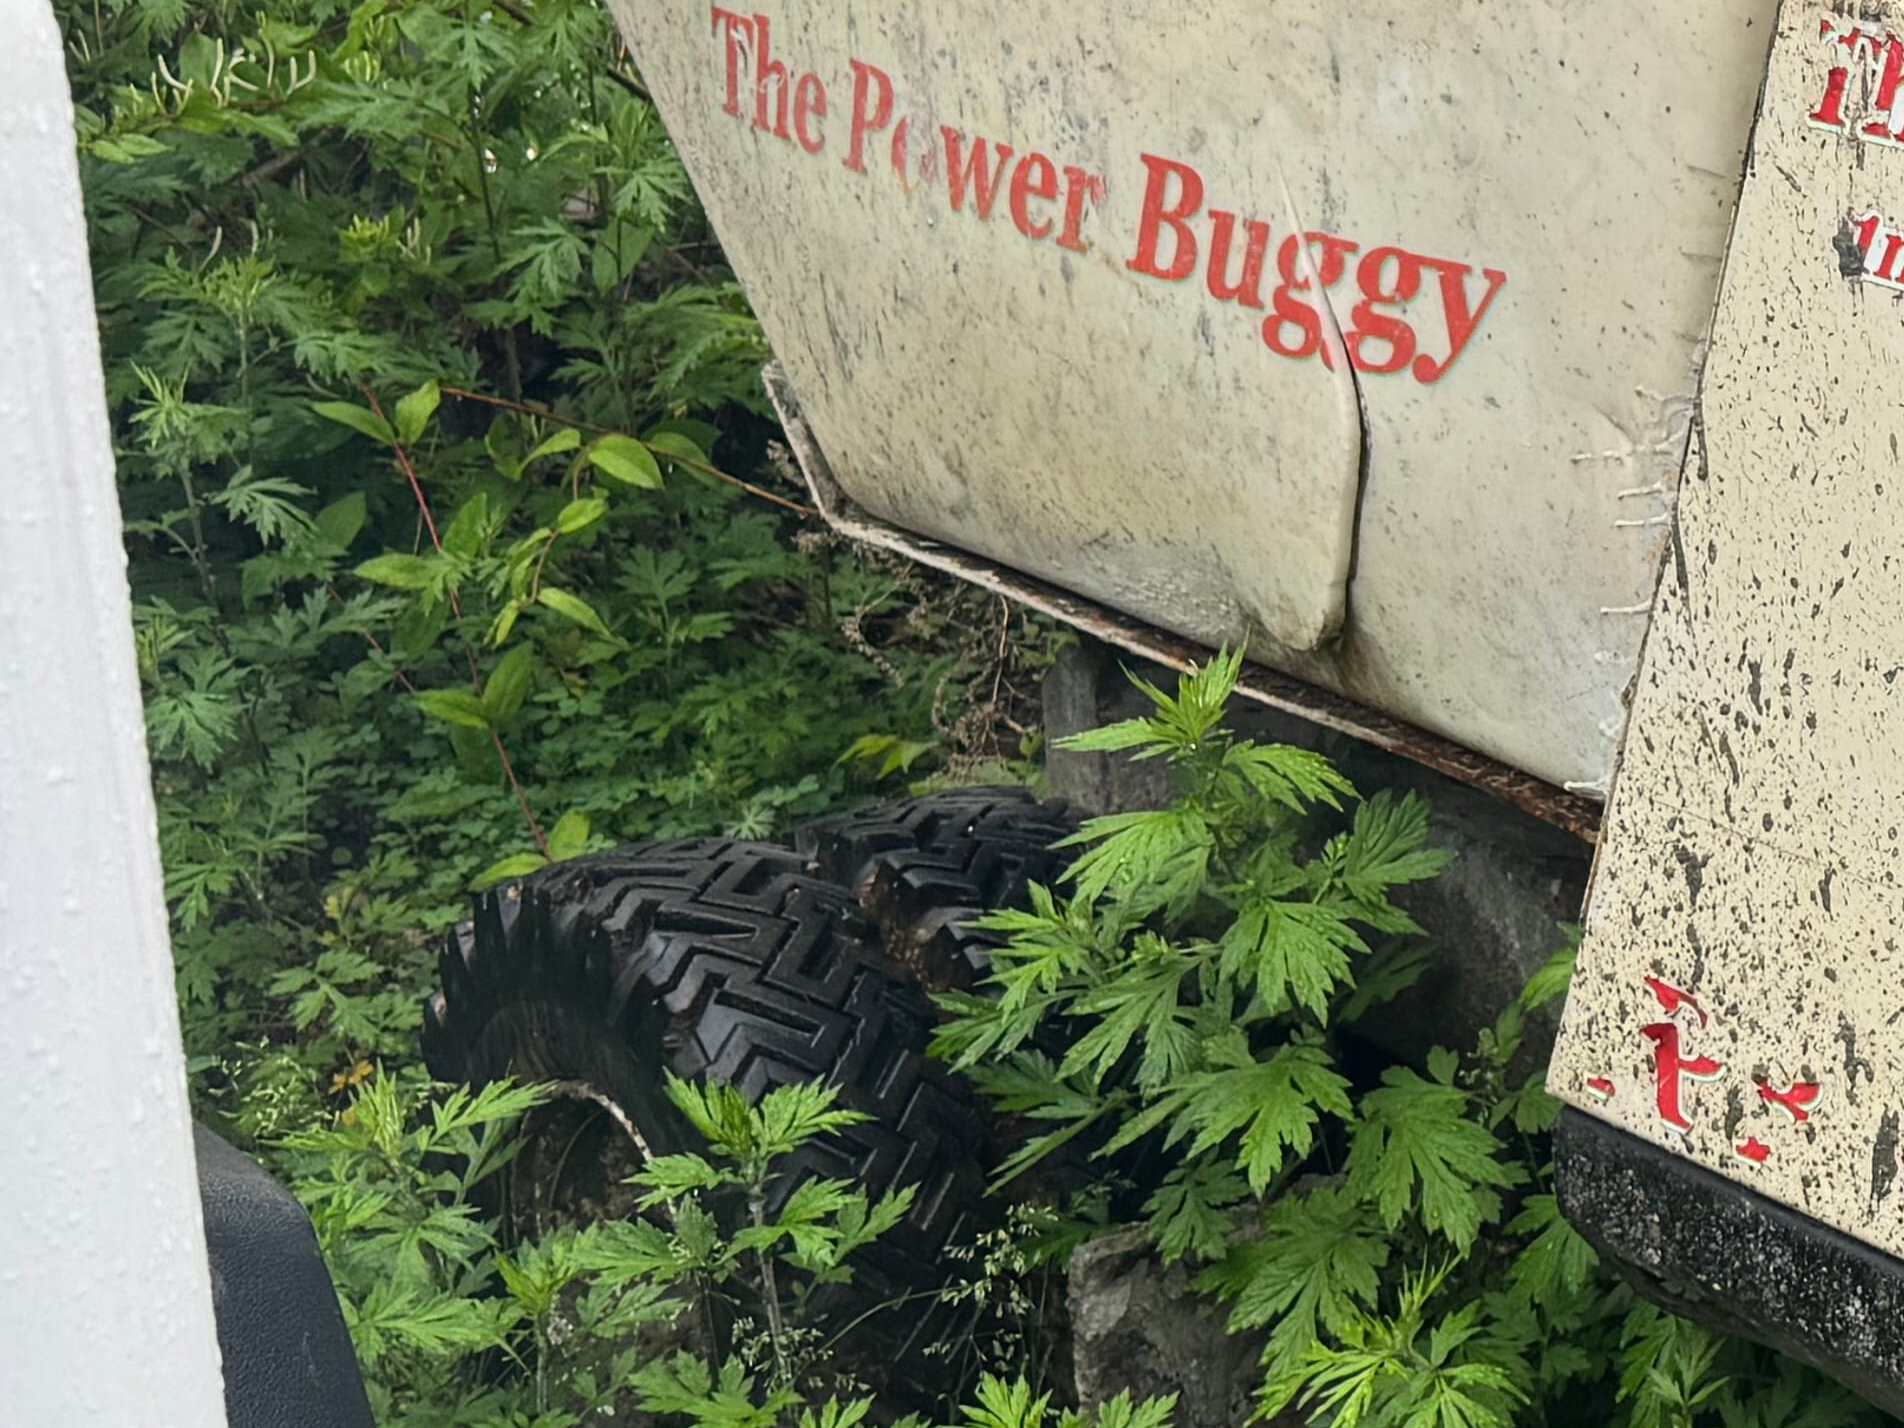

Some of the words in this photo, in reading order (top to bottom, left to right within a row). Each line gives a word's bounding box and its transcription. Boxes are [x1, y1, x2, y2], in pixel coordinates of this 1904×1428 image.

[711, 5, 827, 155] The
[841, 57, 1107, 255] Power
[1126, 153, 1508, 385] Buggy
